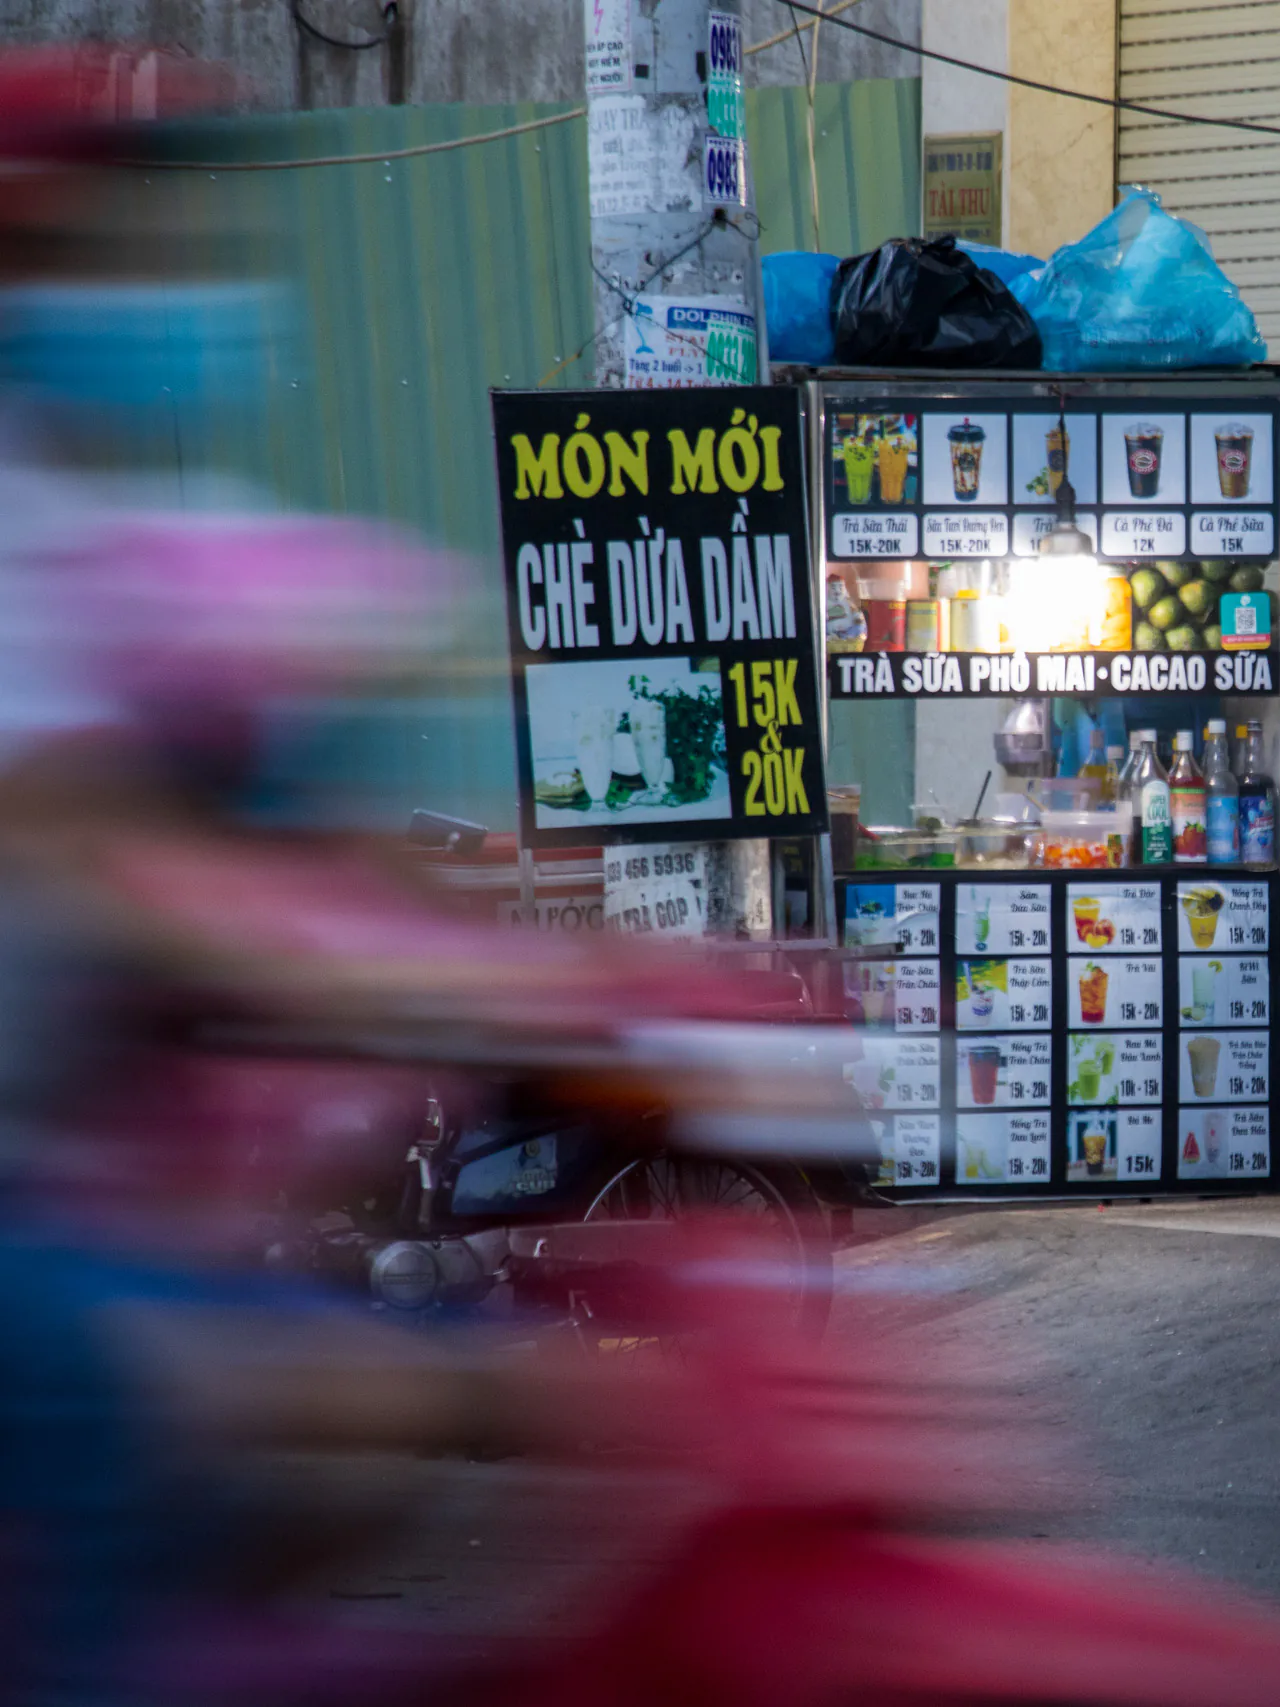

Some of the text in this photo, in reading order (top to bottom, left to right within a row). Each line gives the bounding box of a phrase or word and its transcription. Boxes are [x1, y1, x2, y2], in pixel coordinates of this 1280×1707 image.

[511, 408, 784, 500] MÓN MỚI
[843, 518, 859, 533] Trà
[863, 518, 882, 533] Sữa
[1200, 516, 1264, 532] Cà Phê Sữa
[1133, 538, 1154, 552] 12K
[1221, 538, 1244, 552] 15K
[516, 497, 796, 651] CHÈ DỪA DẦM
[838, 651, 895, 692] TRÀ
[902, 652, 963, 692] SỮA
[1037, 654, 1095, 692] MAI
[1110, 654, 1206, 691] CACAO
[1214, 651, 1272, 690] SỮA
[728, 659, 802, 728] 15K
[760, 718, 783, 755] &
[742, 747, 811, 818] 20K
[653, 853, 694, 876] 5936
[656, 892, 688, 929] GÓP
[1126, 1156, 1154, 1173] 15k
